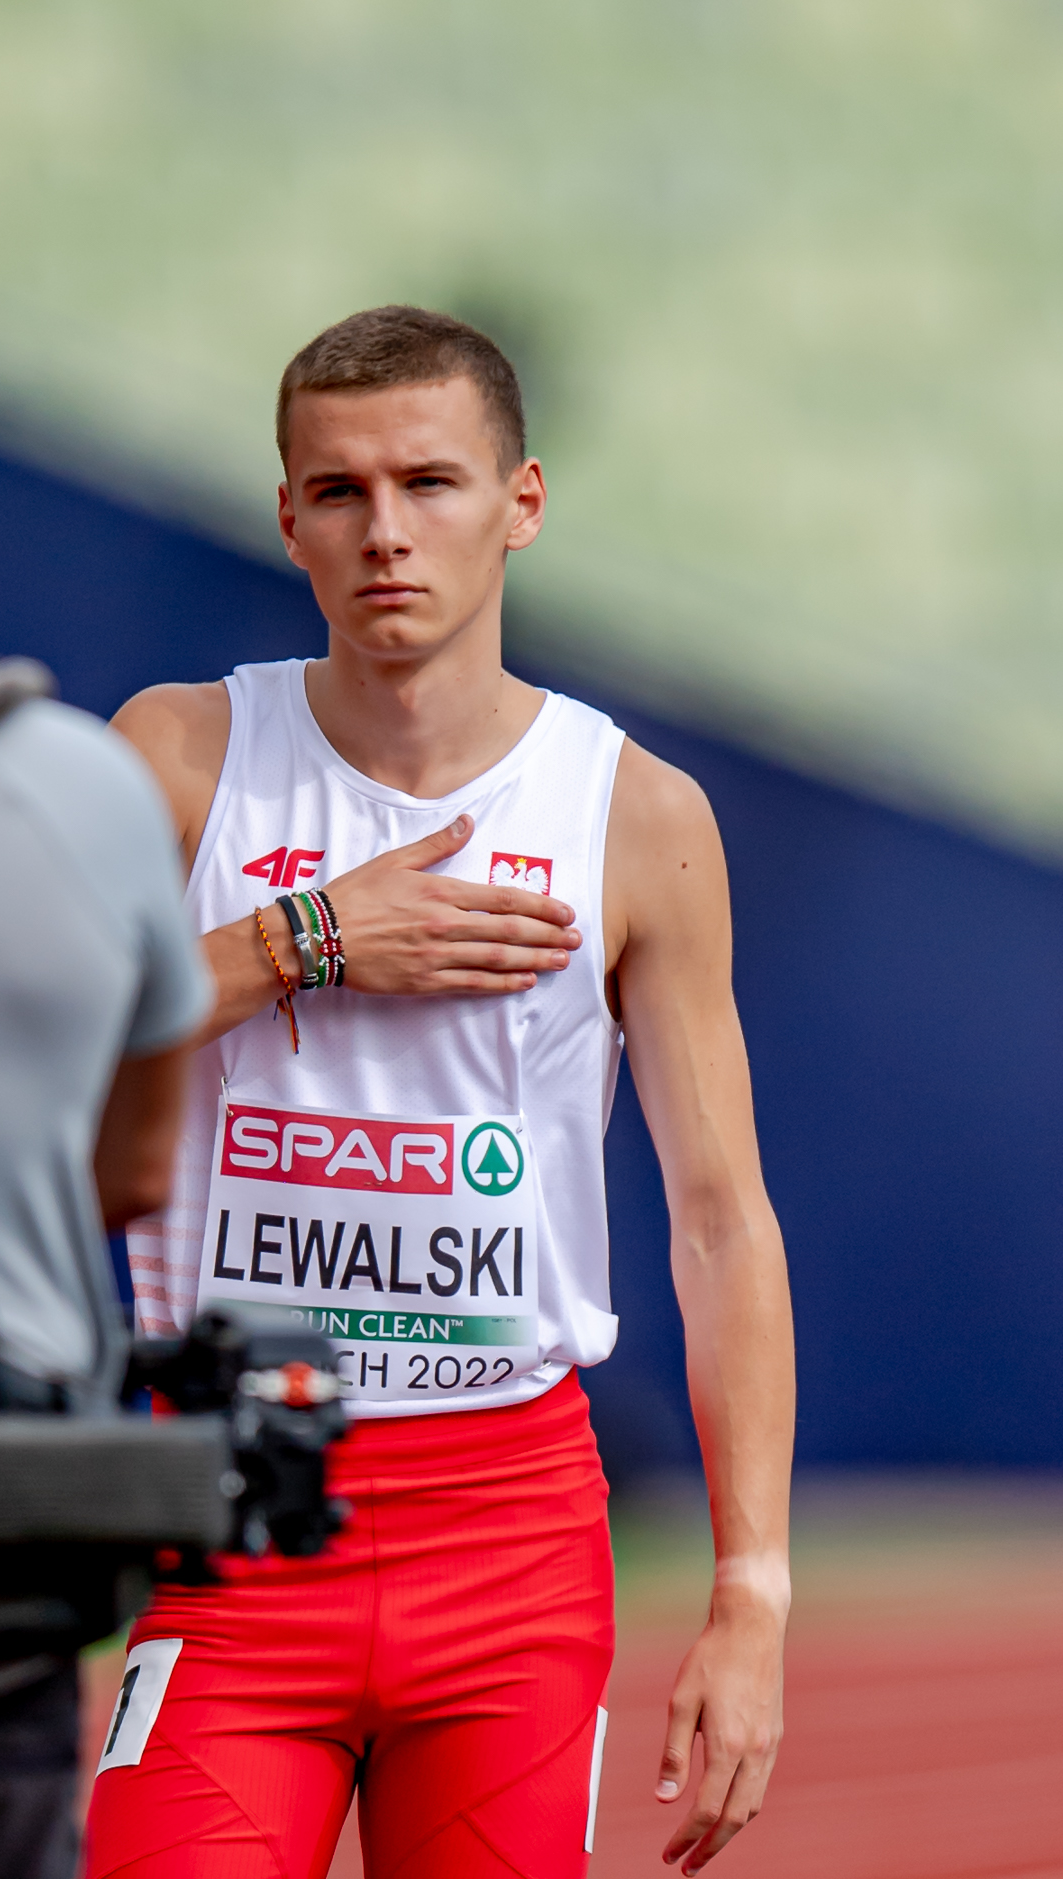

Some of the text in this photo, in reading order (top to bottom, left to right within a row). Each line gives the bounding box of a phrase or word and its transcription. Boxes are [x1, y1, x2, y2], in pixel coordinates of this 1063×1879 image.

[242, 846, 325, 888] 4F
[229, 1117, 447, 1184] SPAR
[213, 1209, 523, 1296] LEWALSKI
[334, 1350, 514, 1389] CH 2022
